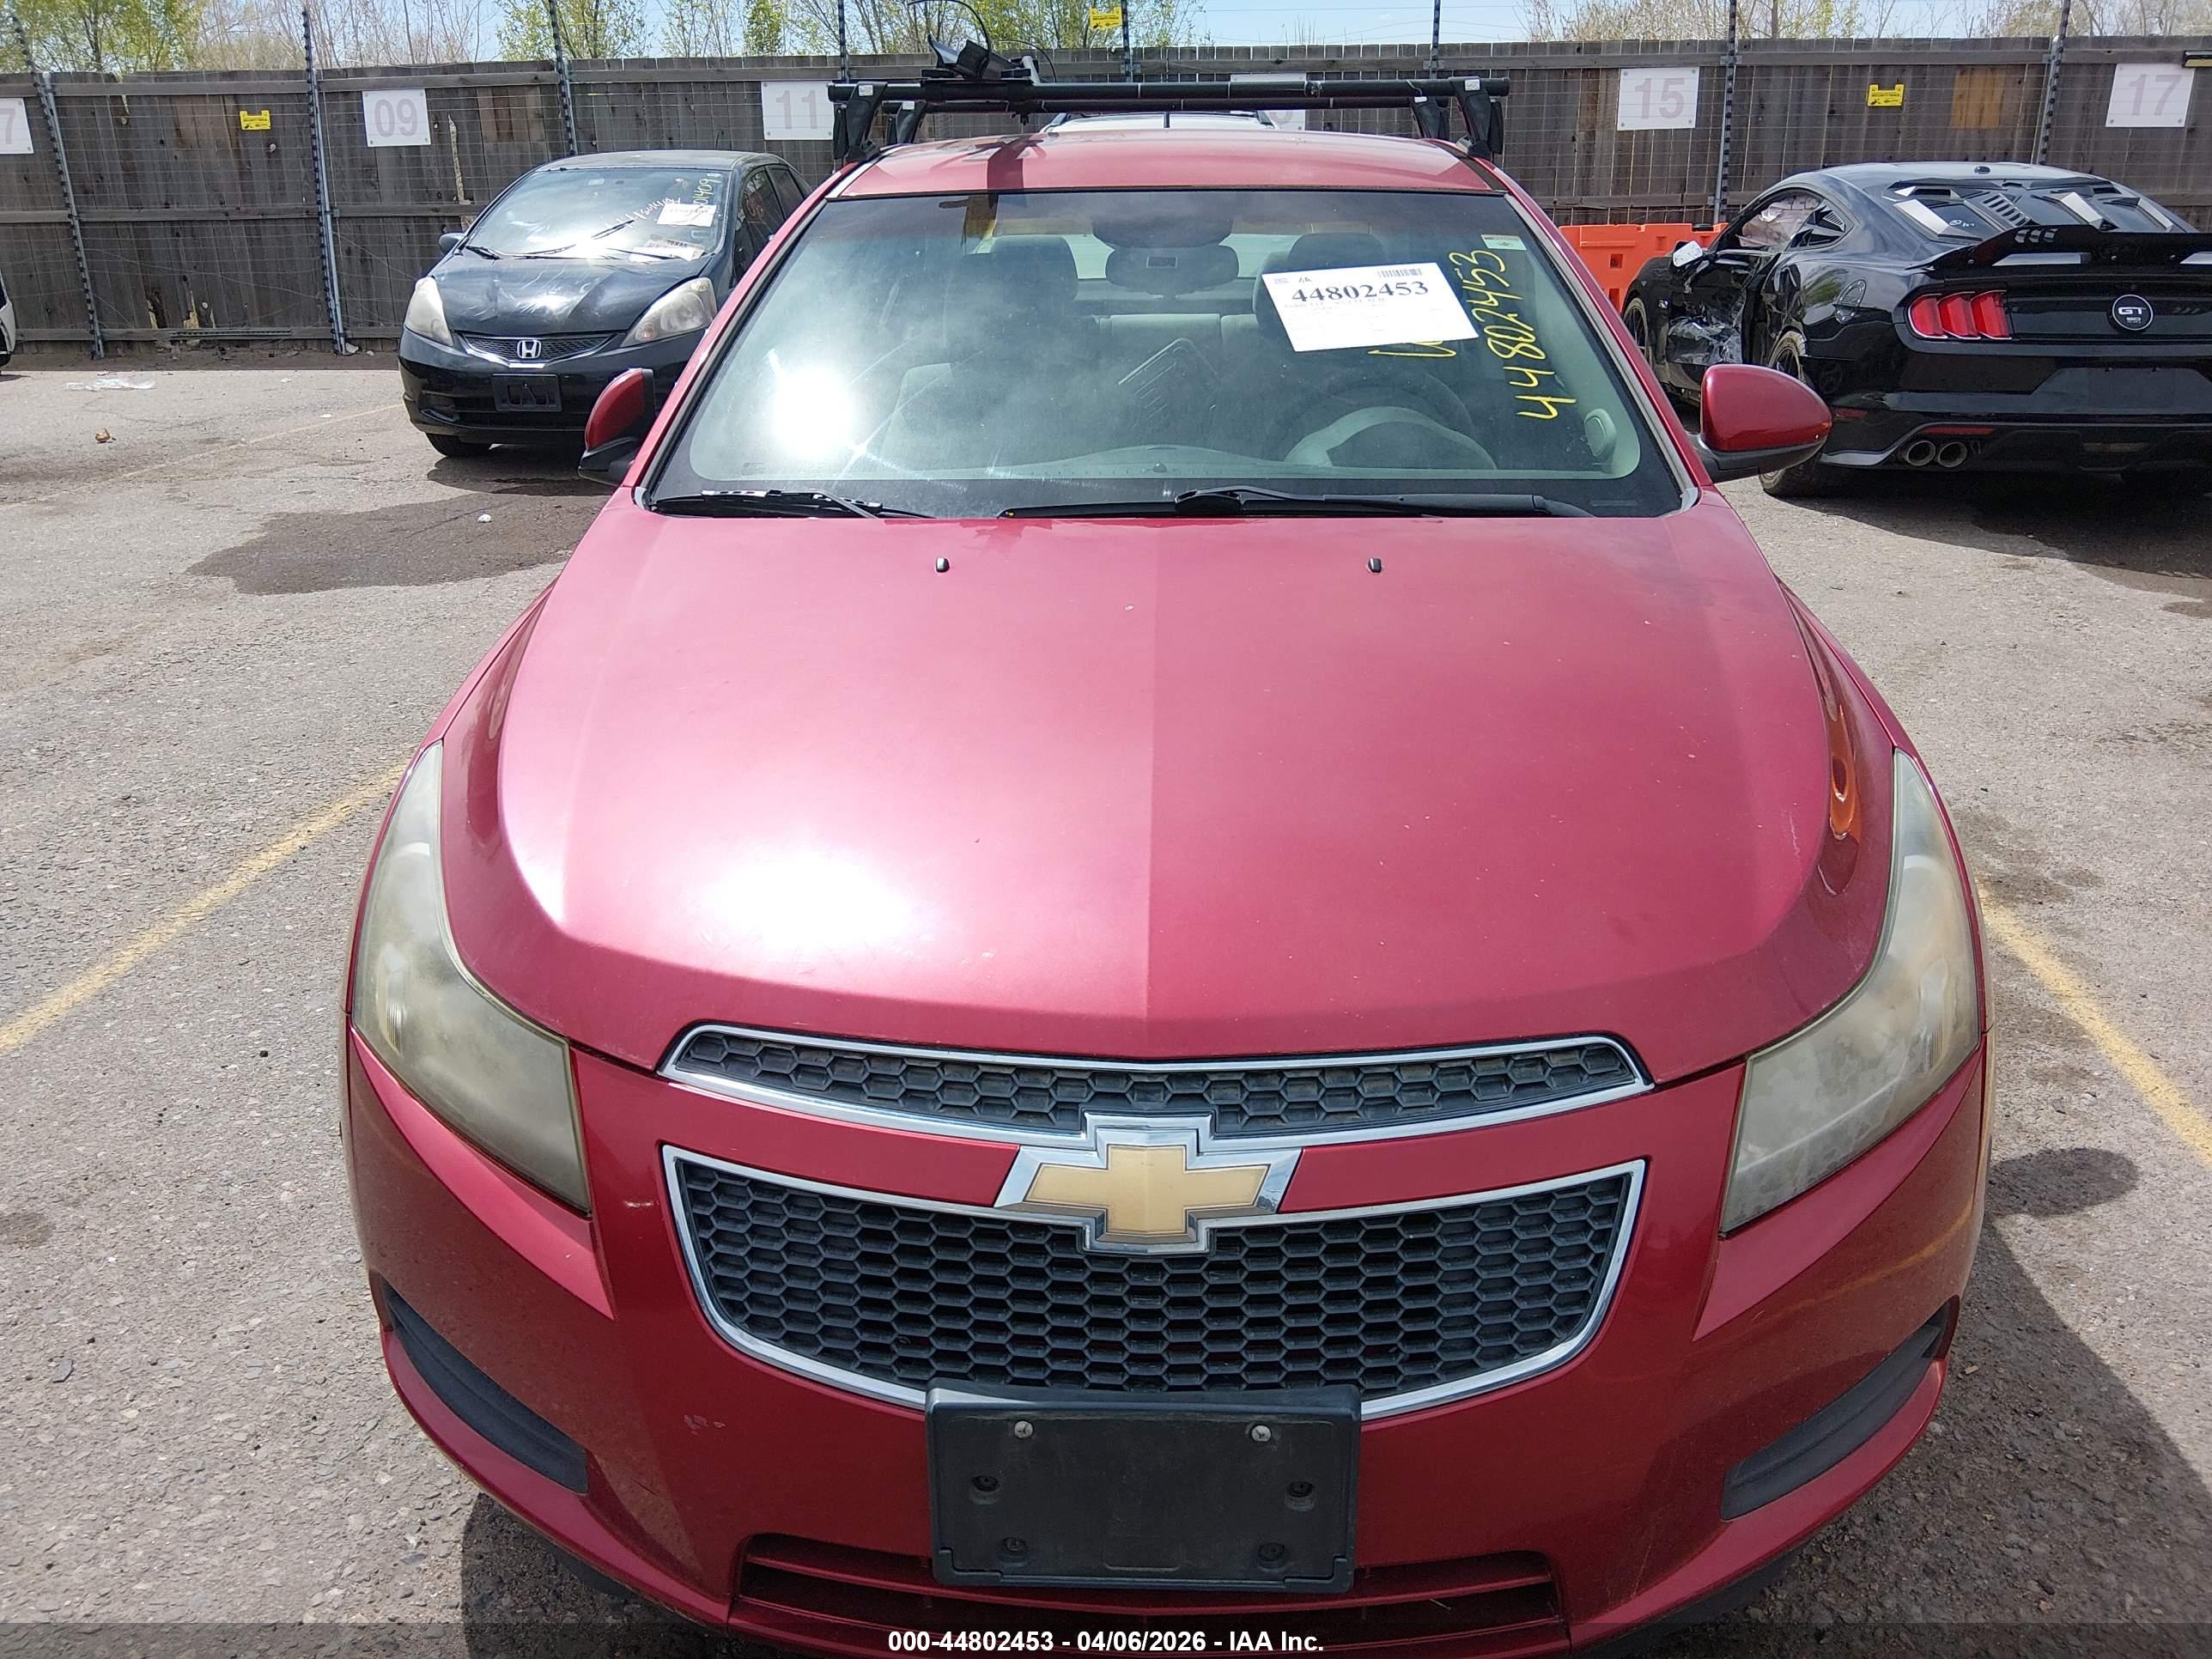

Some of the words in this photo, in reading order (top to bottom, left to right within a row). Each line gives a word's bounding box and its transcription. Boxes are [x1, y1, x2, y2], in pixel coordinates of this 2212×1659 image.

[776, 90, 817, 130] 11
[1635, 78, 1685, 119] 15
[2129, 75, 2182, 116] 17
[374, 99, 418, 137] 09
[1291, 281, 1429, 302] 44802453
[2118, 307, 2147, 315] GT
[1449, 250, 1577, 420] 44802453
